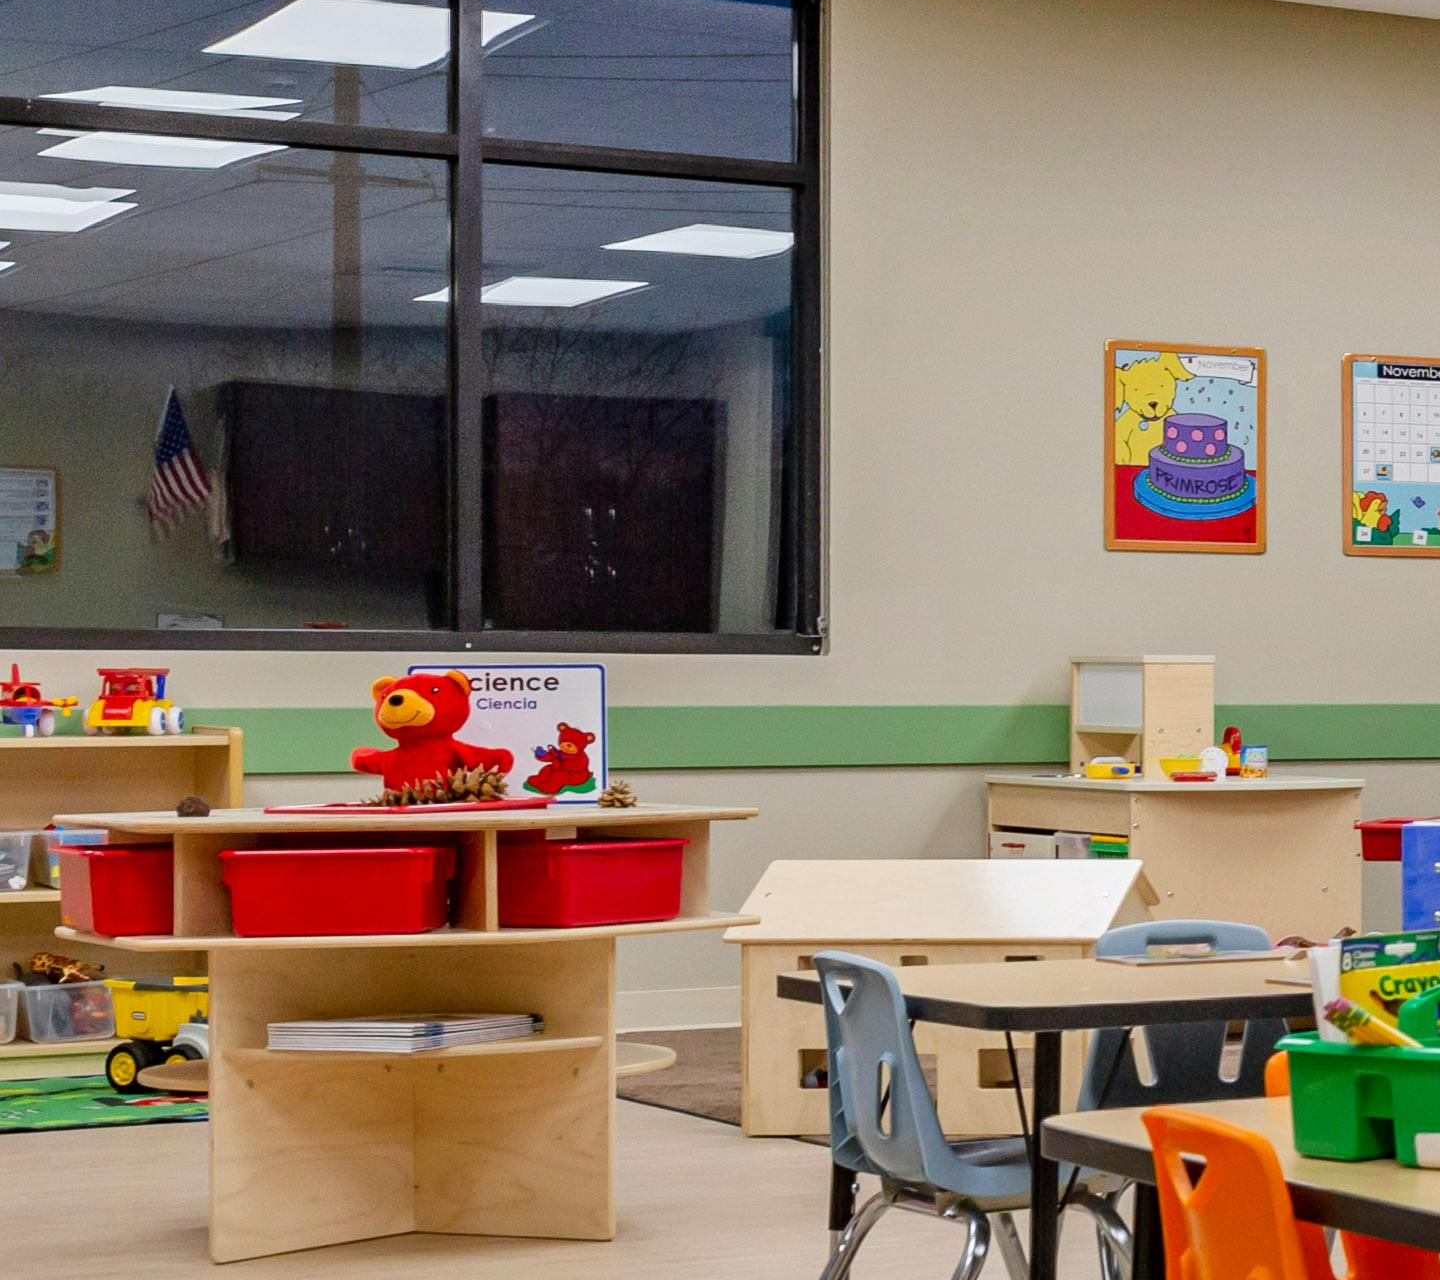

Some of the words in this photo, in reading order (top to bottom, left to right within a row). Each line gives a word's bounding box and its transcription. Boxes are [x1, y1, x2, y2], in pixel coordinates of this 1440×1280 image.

[1155, 467, 1242, 495] PRIMROSE
[470, 672, 560, 691] cience
[476, 698, 538, 710] Ciencia
[1342, 952, 1352, 971] 8
